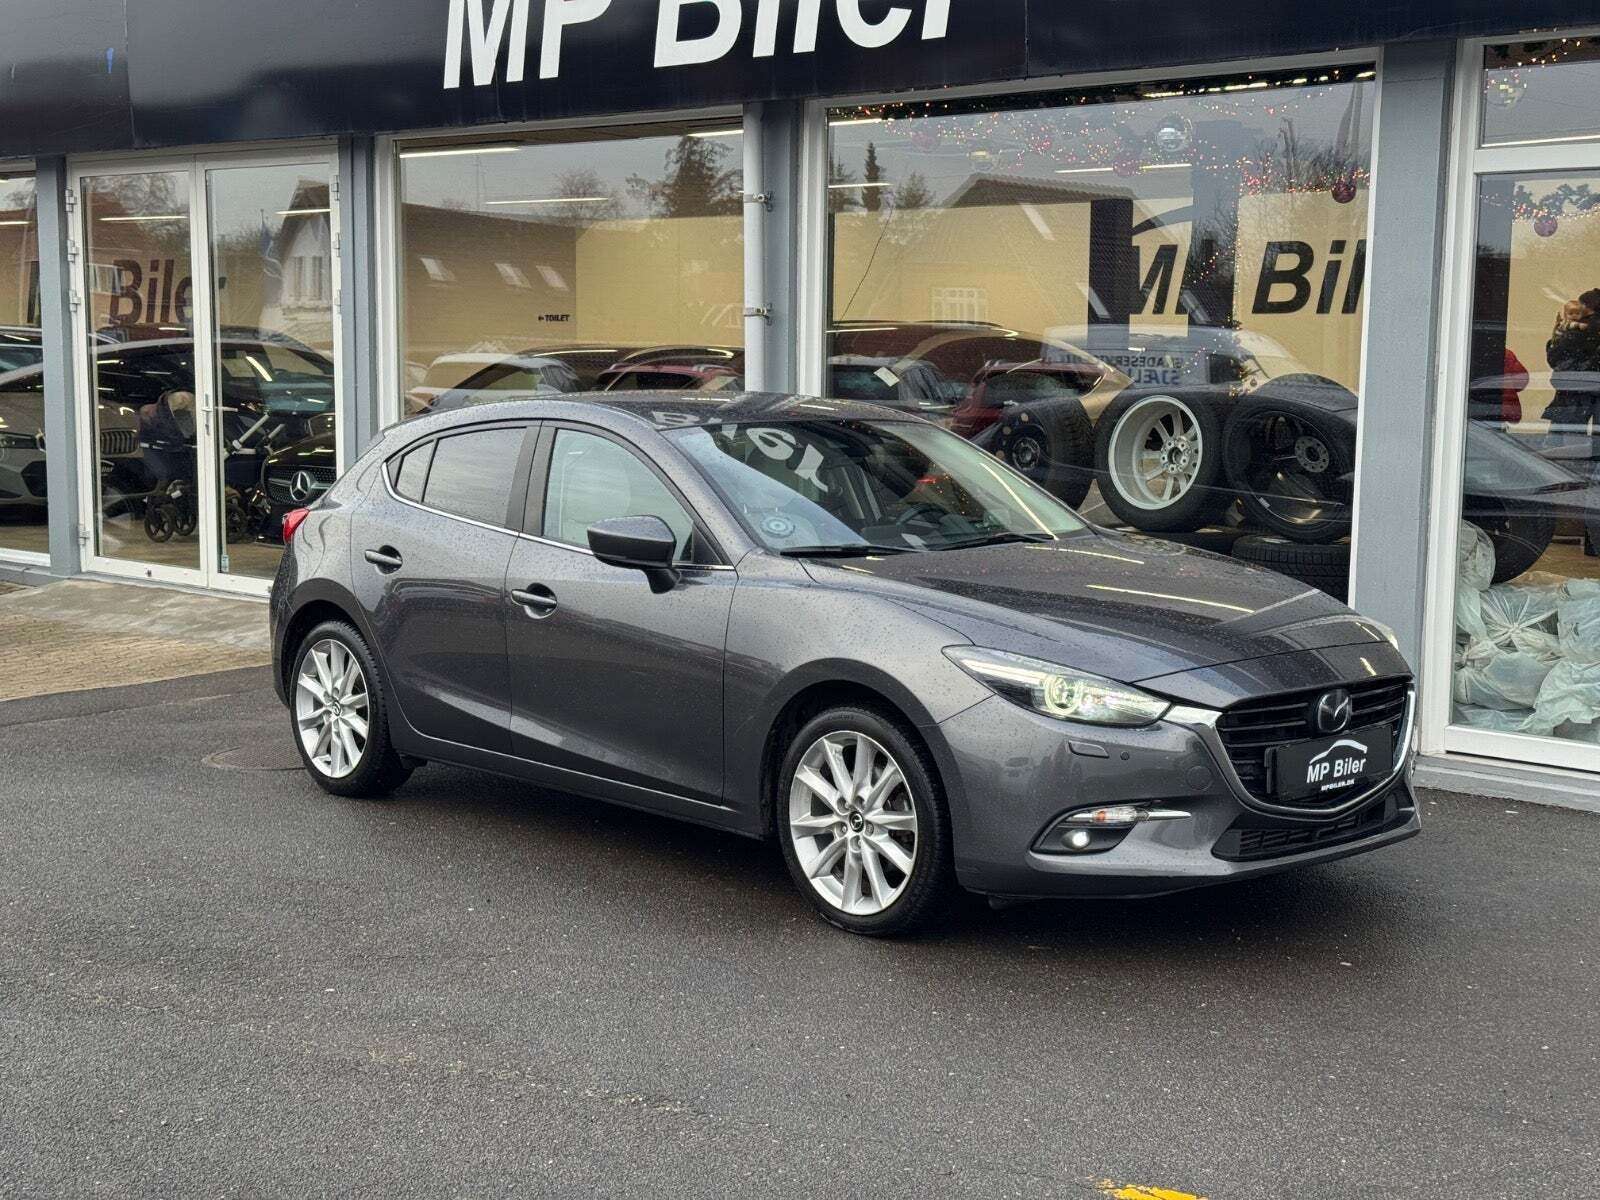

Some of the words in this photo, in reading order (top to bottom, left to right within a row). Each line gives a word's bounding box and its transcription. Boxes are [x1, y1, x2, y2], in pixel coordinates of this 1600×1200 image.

[109, 259, 226, 325] Bile
[1251, 239, 1368, 315] Bil
[544, 314, 570, 322] TOILET
[1306, 762, 1330, 784] MP
[1333, 757, 1367, 778] Biler
